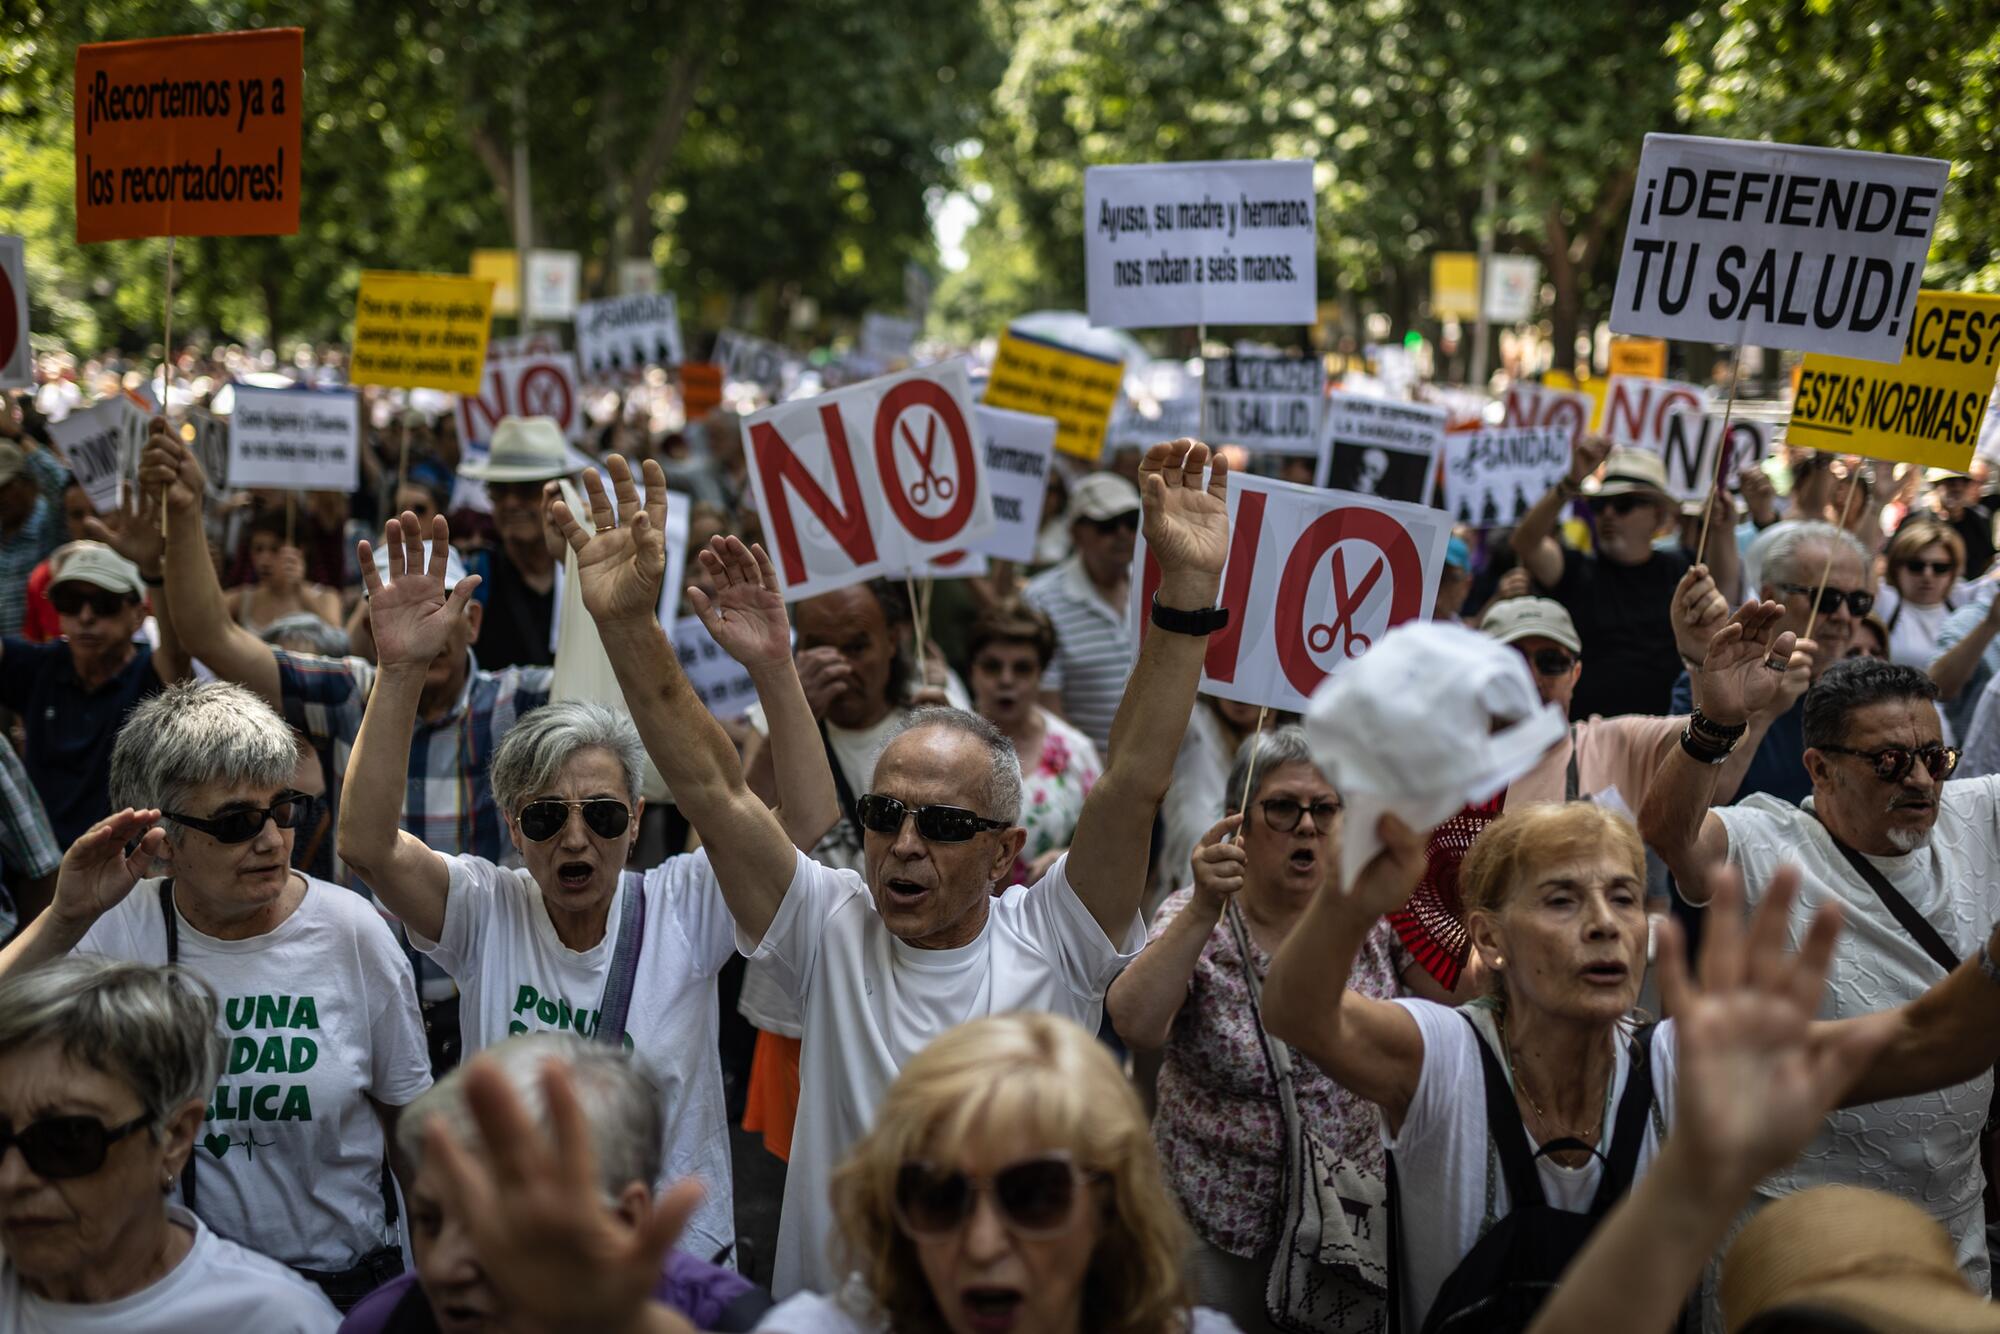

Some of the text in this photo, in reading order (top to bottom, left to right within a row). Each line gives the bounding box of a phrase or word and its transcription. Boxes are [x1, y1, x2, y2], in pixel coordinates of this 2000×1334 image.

[87, 70, 285, 135] ¡Recortemos ya a
[87, 147, 284, 206] los recortadores!
[1640, 167, 1938, 238] ¡DEFIENDE
[1098, 192, 1312, 242] Ayuso, su madre y hermano,
[1114, 247, 1298, 287] nos roban a seis manos.
[1632, 238, 1916, 337] TU SALUD!
[1792, 371, 1991, 446] ESTAS NORMAS!
[748, 378, 978, 588] NO
[225, 995, 319, 1030] UNA
[228, 1035, 318, 1075] DAD
